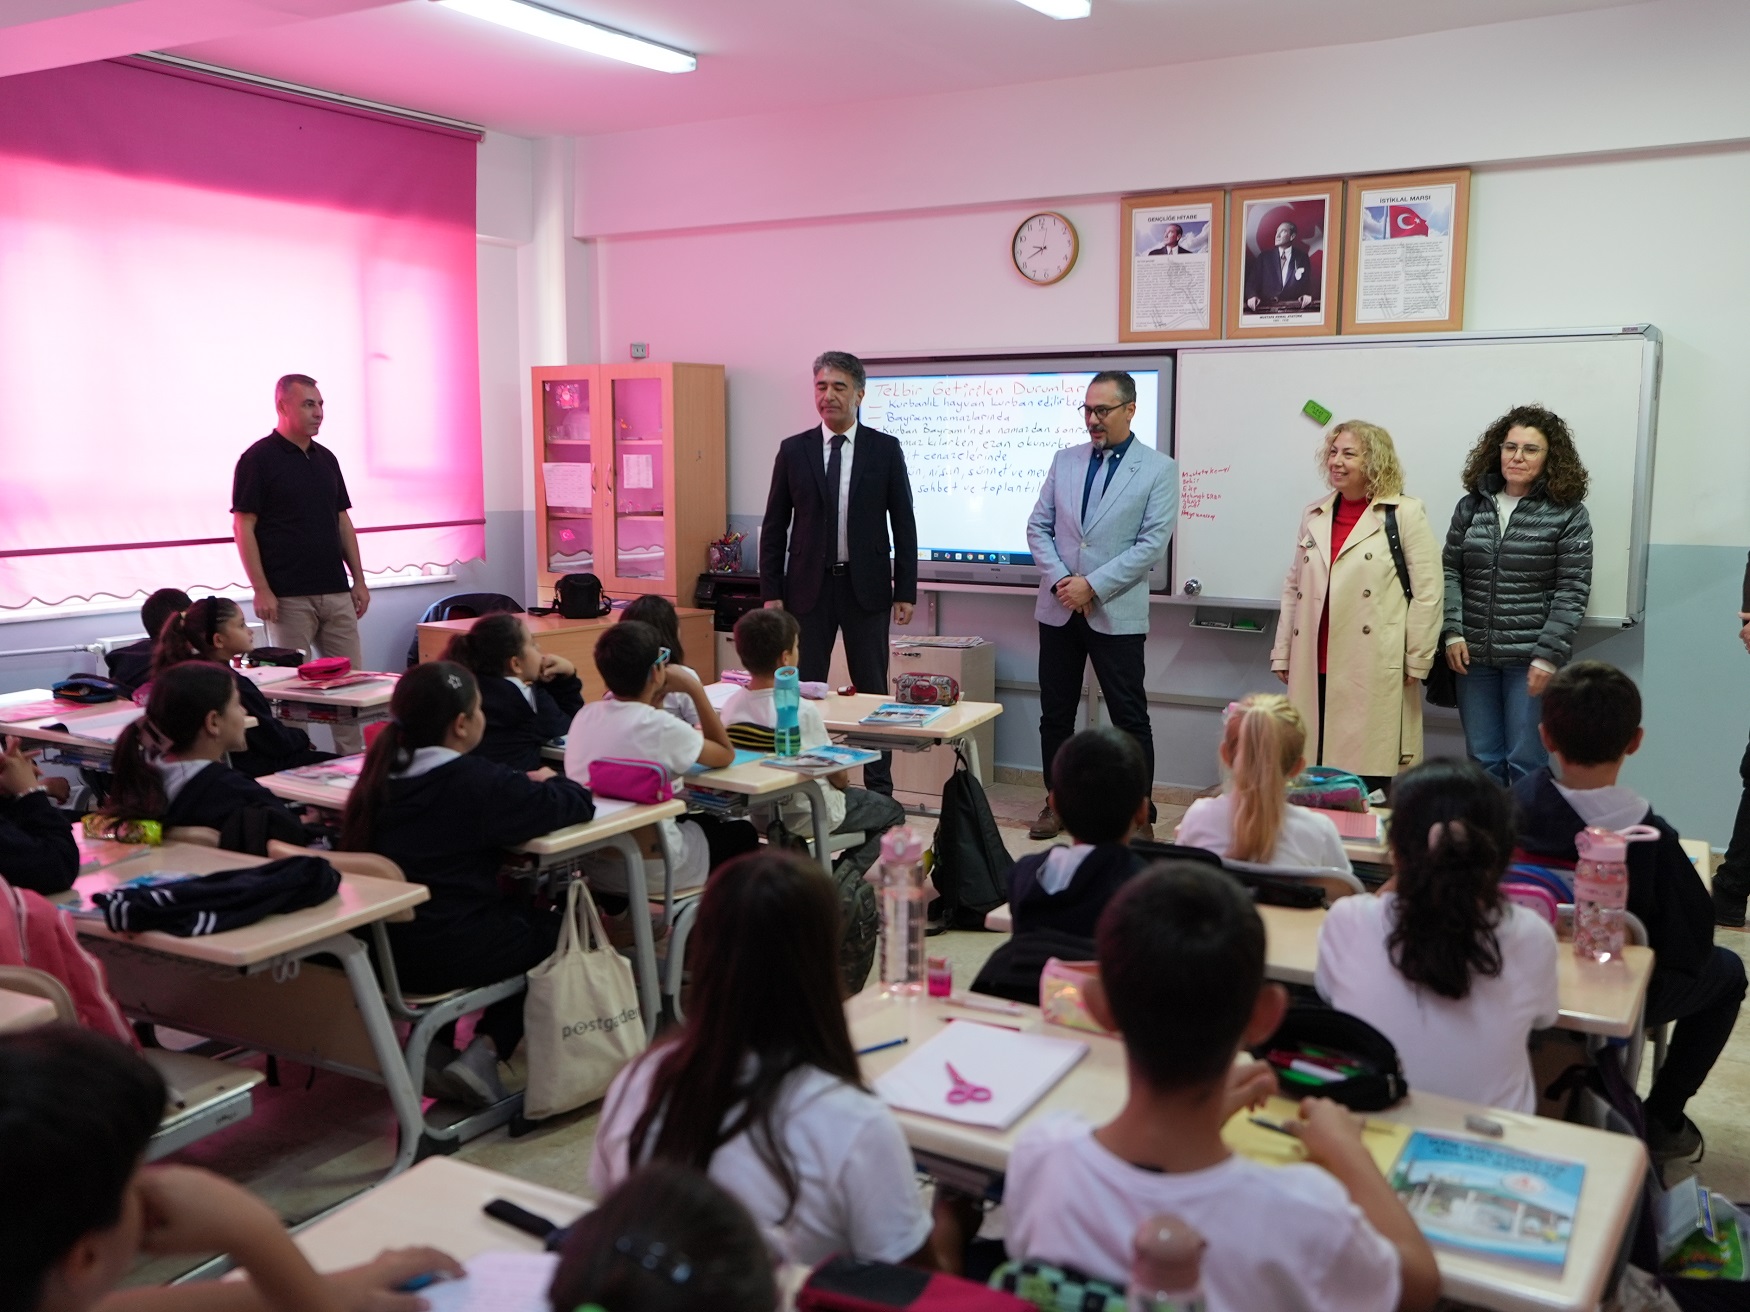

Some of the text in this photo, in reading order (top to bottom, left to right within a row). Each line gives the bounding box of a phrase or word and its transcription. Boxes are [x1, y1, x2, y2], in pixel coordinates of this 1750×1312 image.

[875, 379, 1086, 397] Tekbir Getirilen Durumlar
[888, 397, 939, 409] Kurbanlık
[943, 397, 985, 413] hayvan
[991, 396, 1034, 407] kurban
[886, 411, 932, 427] Bayram
[882, 425, 918, 435] Kurban
[997, 422, 1051, 434] namazdan
[982, 440, 1011, 449] ezan
[1017, 436, 1071, 449] okunurke
[923, 450, 1007, 462] cenazelerinde
[917, 480, 1041, 496] sohbet ve toplantıl
